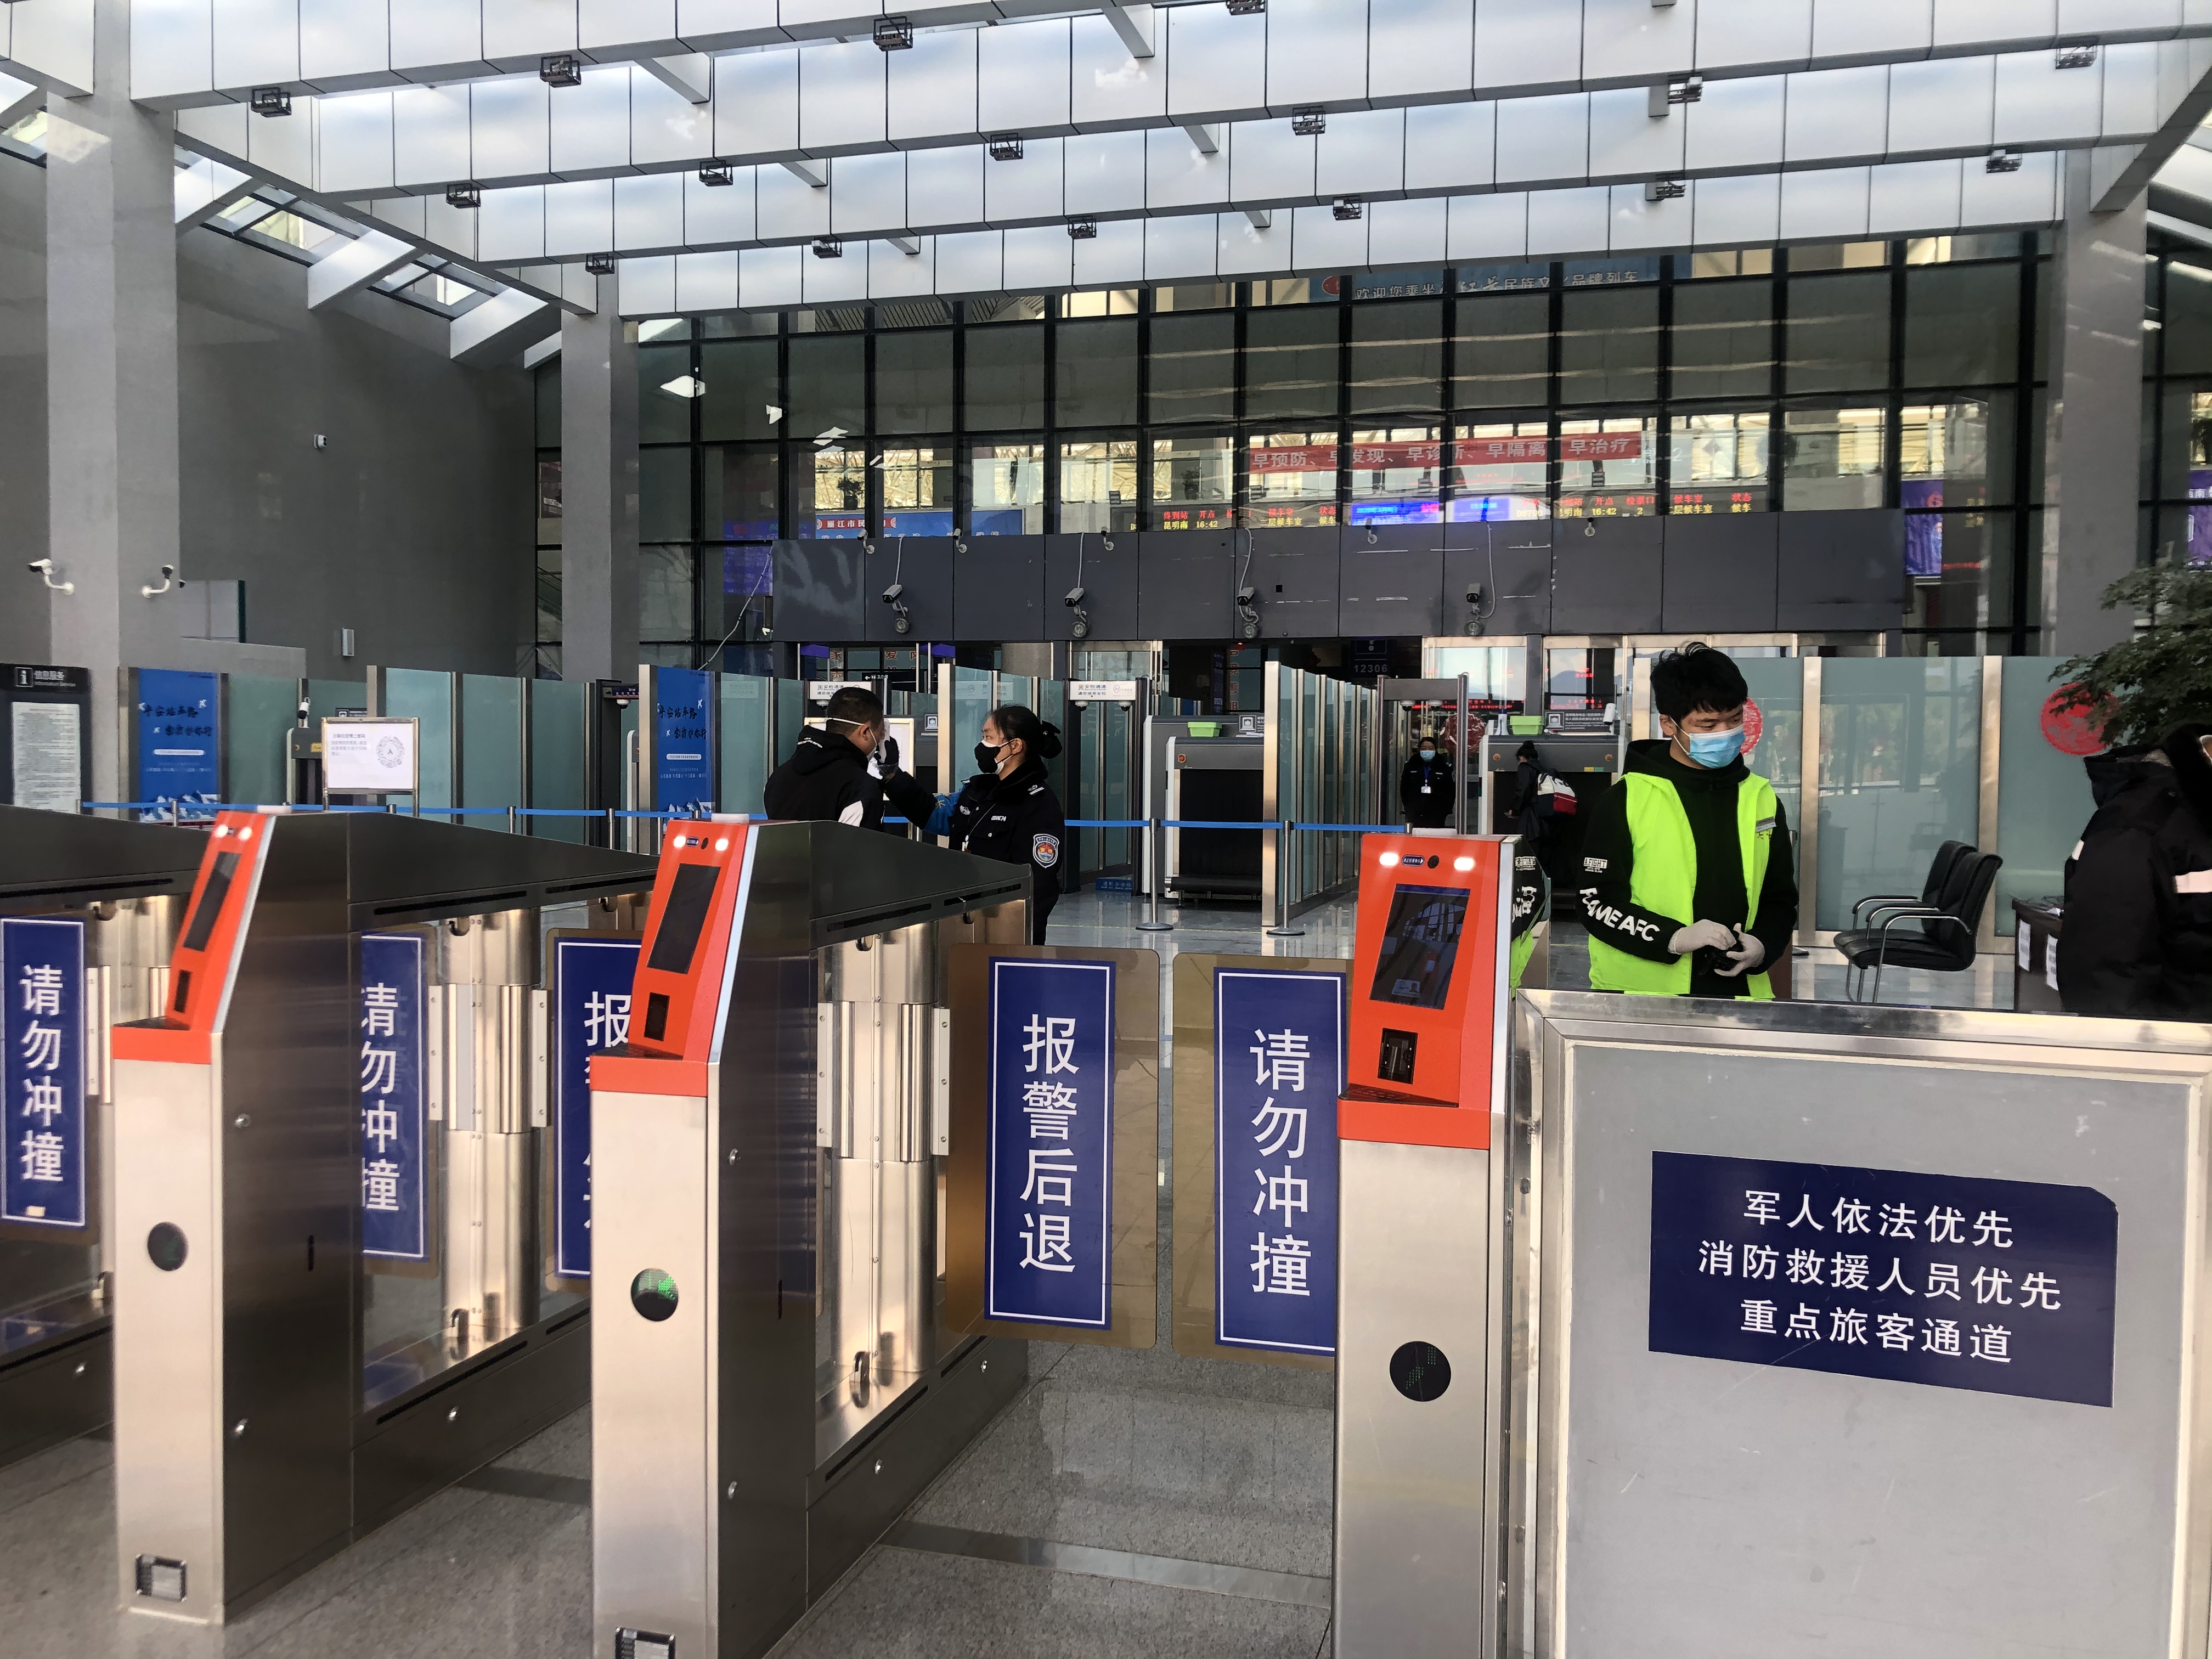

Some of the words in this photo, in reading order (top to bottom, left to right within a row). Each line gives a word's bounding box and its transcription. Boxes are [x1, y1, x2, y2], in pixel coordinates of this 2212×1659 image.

[1164, 521, 1188, 530] 昆明南
[1260, 517, 1303, 527] 二层候车室
[1592, 507, 1617, 516] 16:42
[1637, 507, 1643, 516] 2
[1354, 664, 1387, 673] 12306
[1617, 915, 1661, 941] AFC
[19, 964, 64, 1182] 请勿冲撞
[1019, 1013, 1080, 1273] 报警后退
[1249, 1029, 1312, 1297] 请勿冲撞
[1743, 1189, 2014, 1249] 军人依法优先
[1697, 1239, 2062, 1311] 消防救援人员优先
[1740, 1298, 2013, 1364] 重点旅客通道
